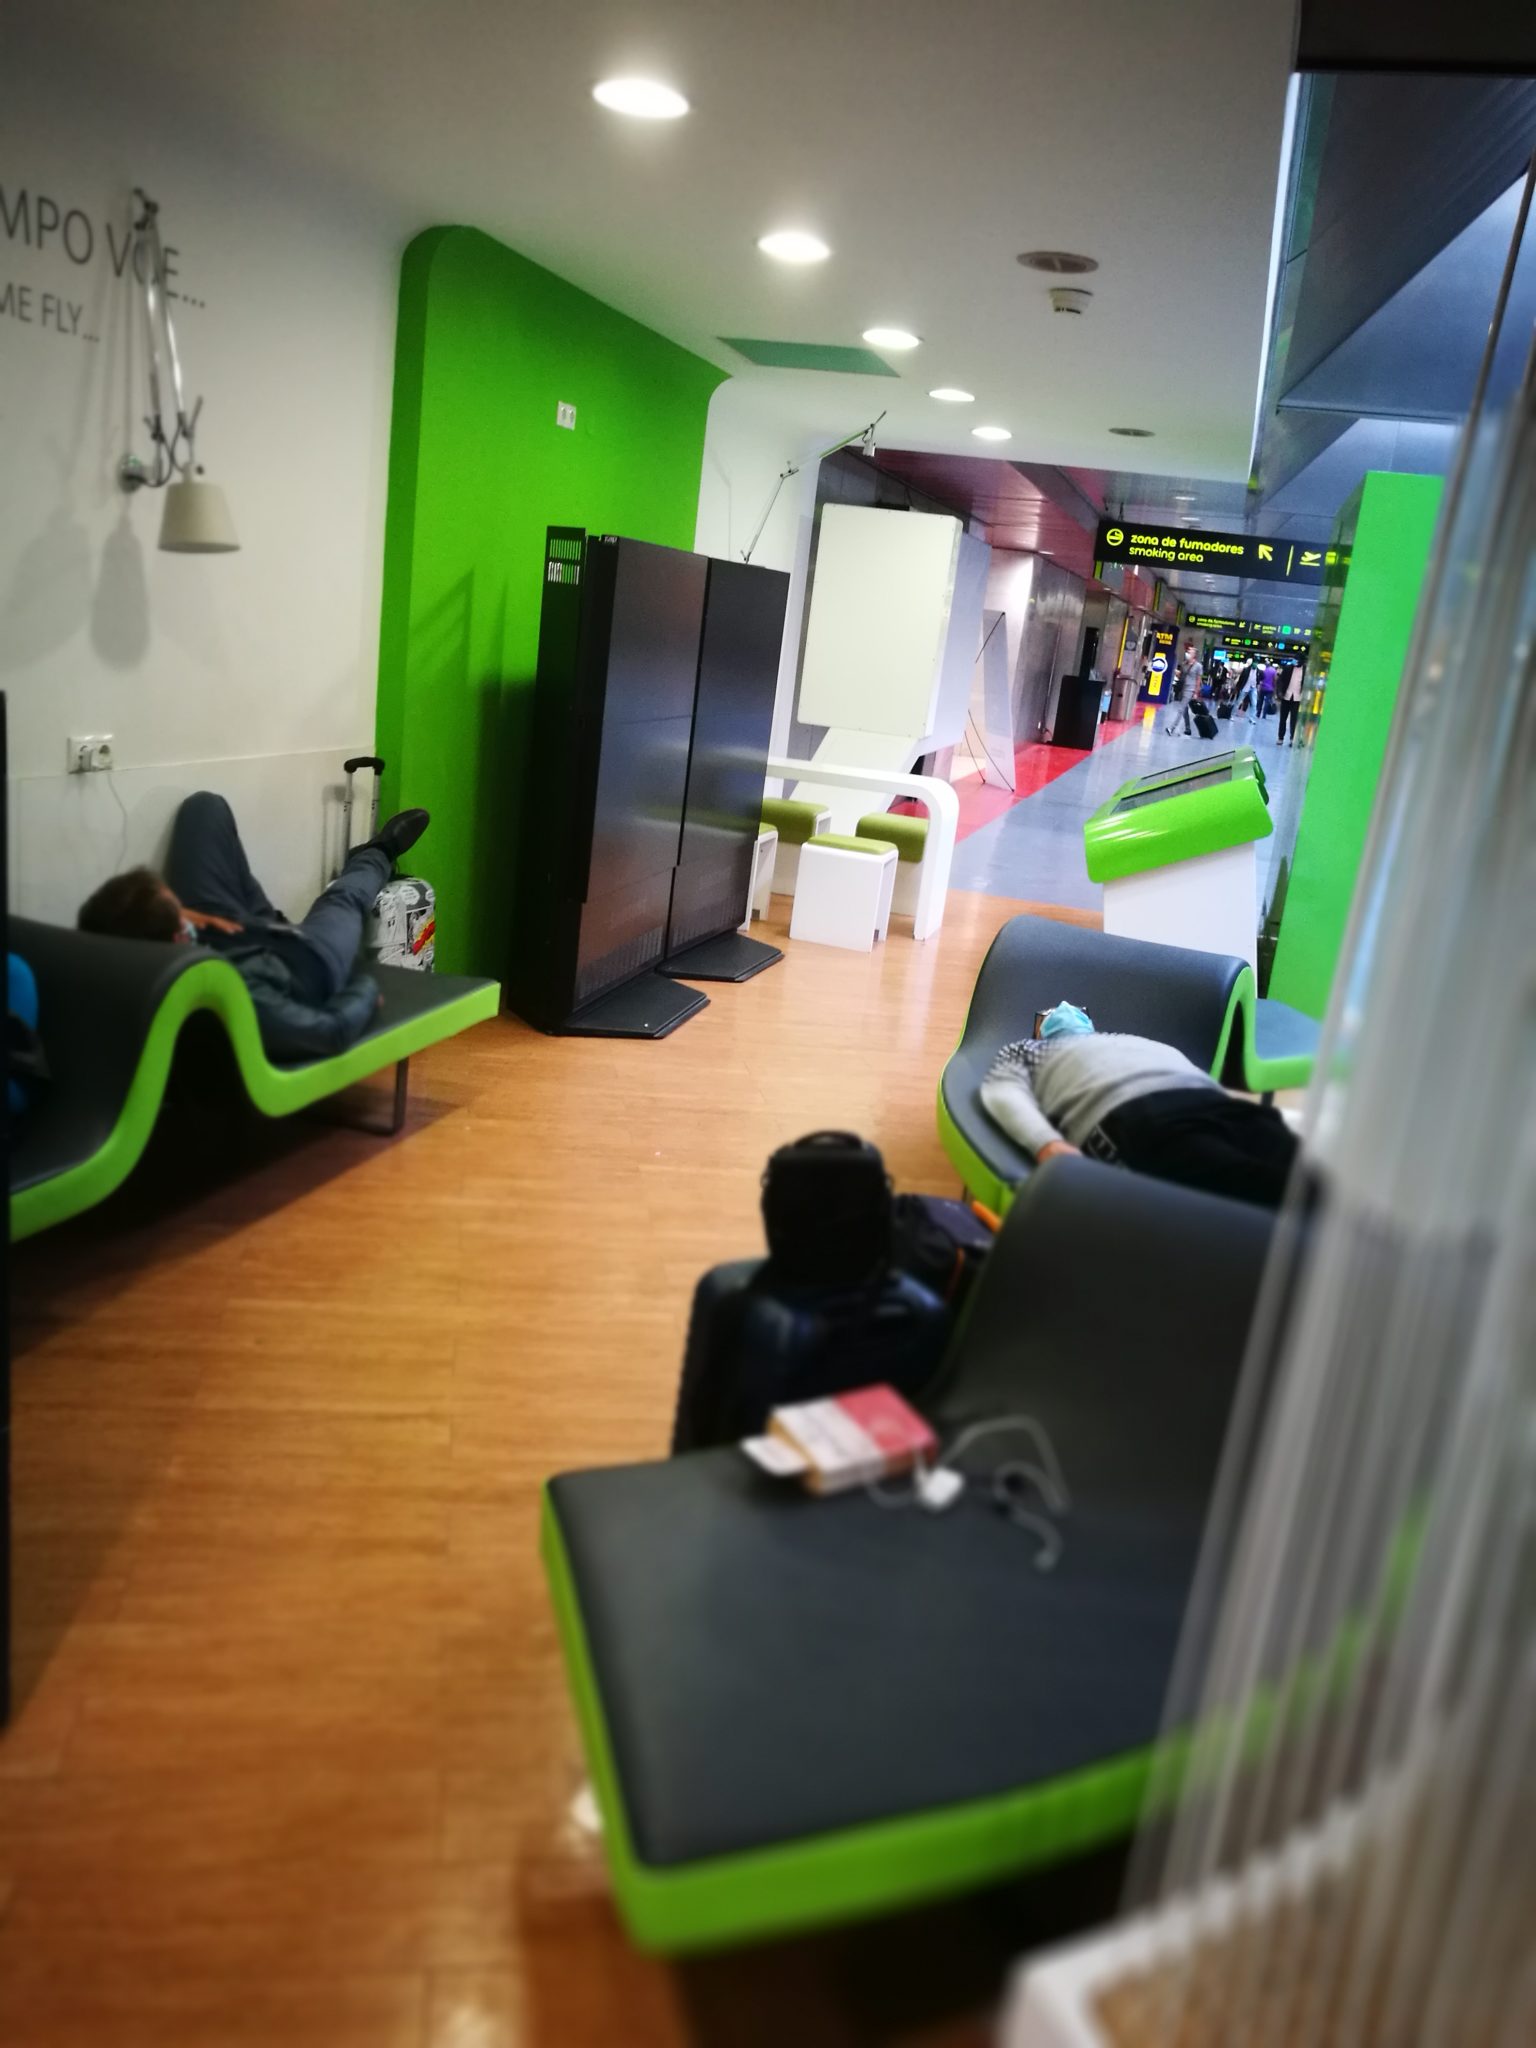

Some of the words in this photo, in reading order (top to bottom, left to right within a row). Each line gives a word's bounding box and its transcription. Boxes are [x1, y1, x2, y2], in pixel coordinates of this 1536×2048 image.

[0, 184, 94, 265] MPO
[1130, 534, 1158, 545] zona
[1161, 536, 1176, 547] de
[1179, 538, 1244, 554] fumadores
[1129, 547, 1175, 561] smoking
[1177, 552, 1203, 562] area
